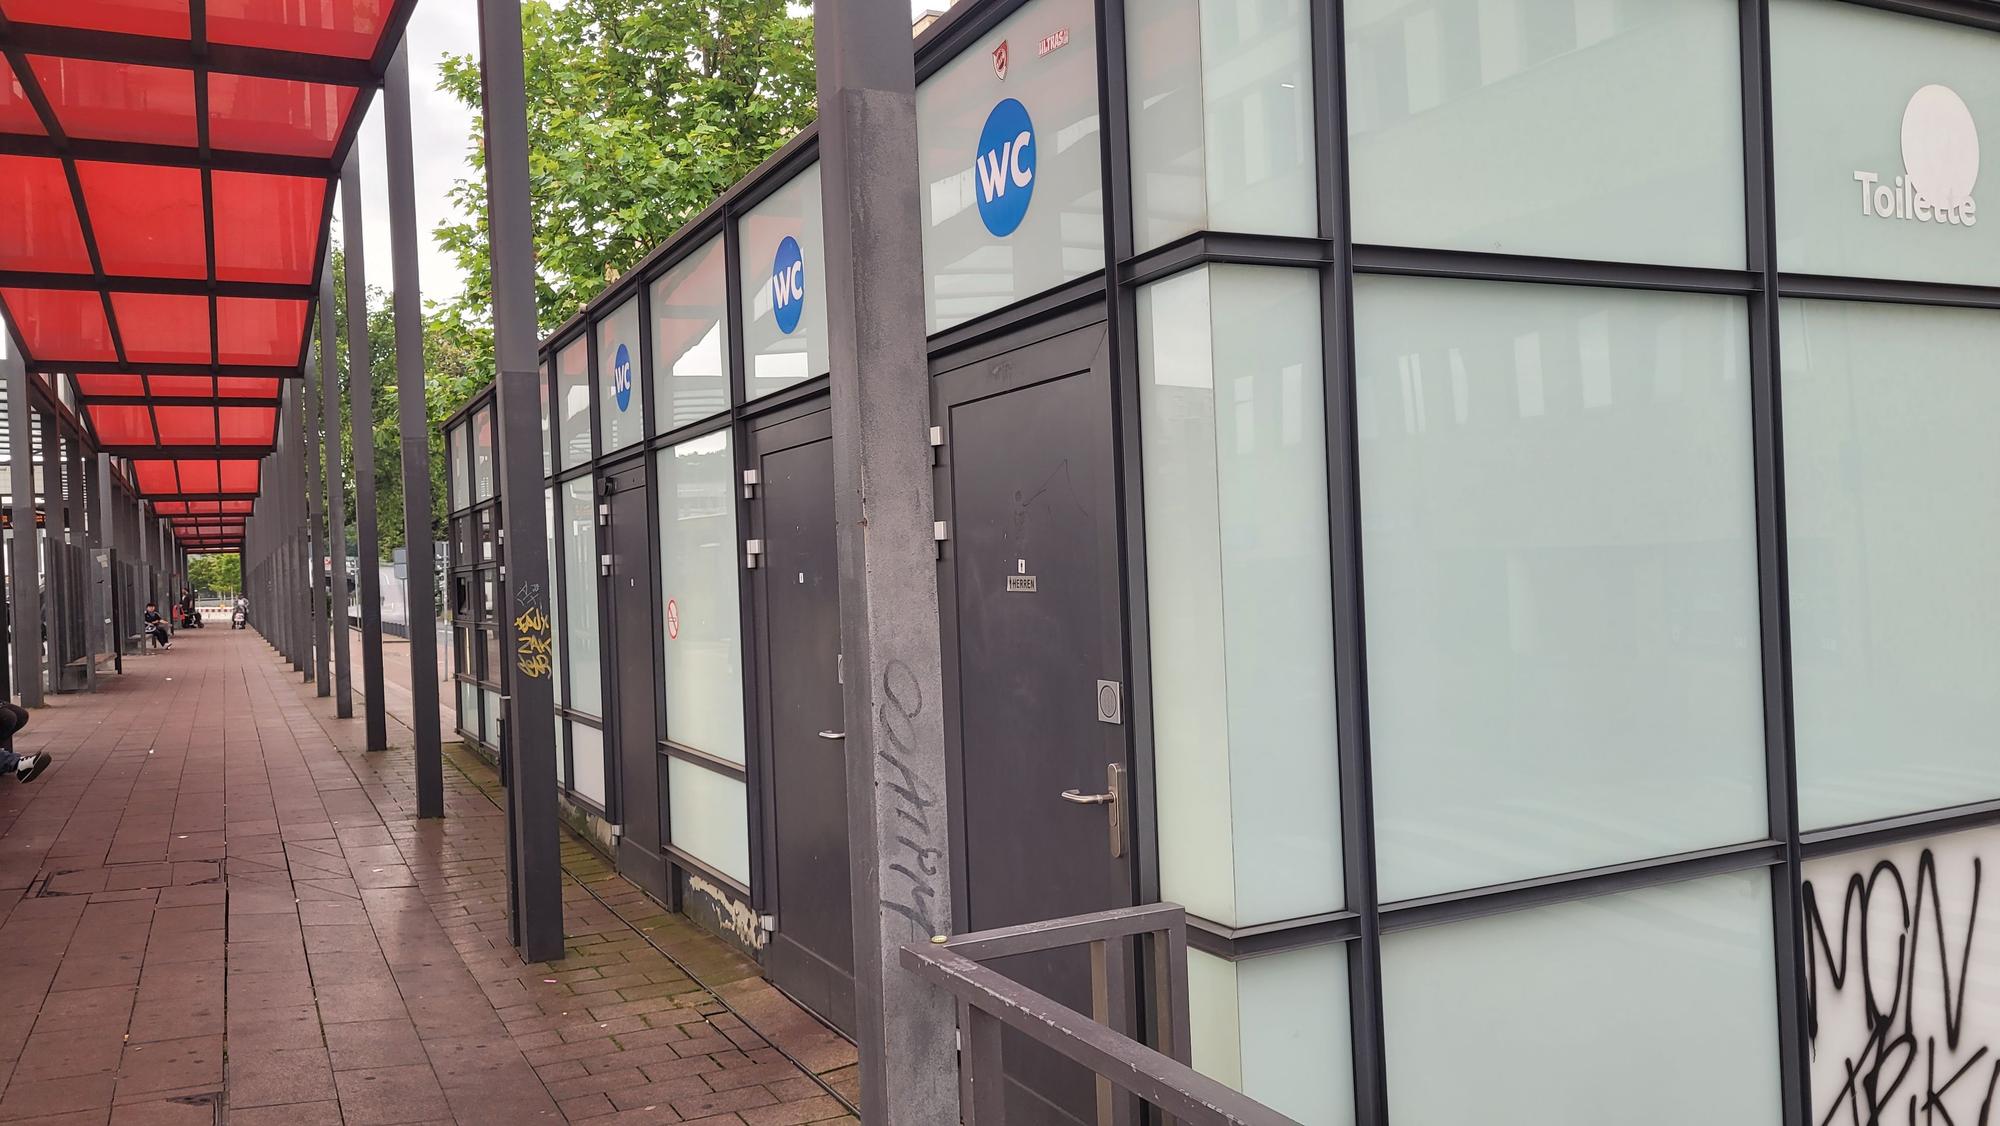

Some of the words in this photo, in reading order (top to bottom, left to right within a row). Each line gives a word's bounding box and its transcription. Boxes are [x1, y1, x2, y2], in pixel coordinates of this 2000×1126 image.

[977, 131, 1032, 203] WC
[1854, 171, 1977, 226] Toilette
[774, 261, 803, 309] WC
[615, 362, 631, 393] WC
[1012, 578, 1035, 589] HERREN
